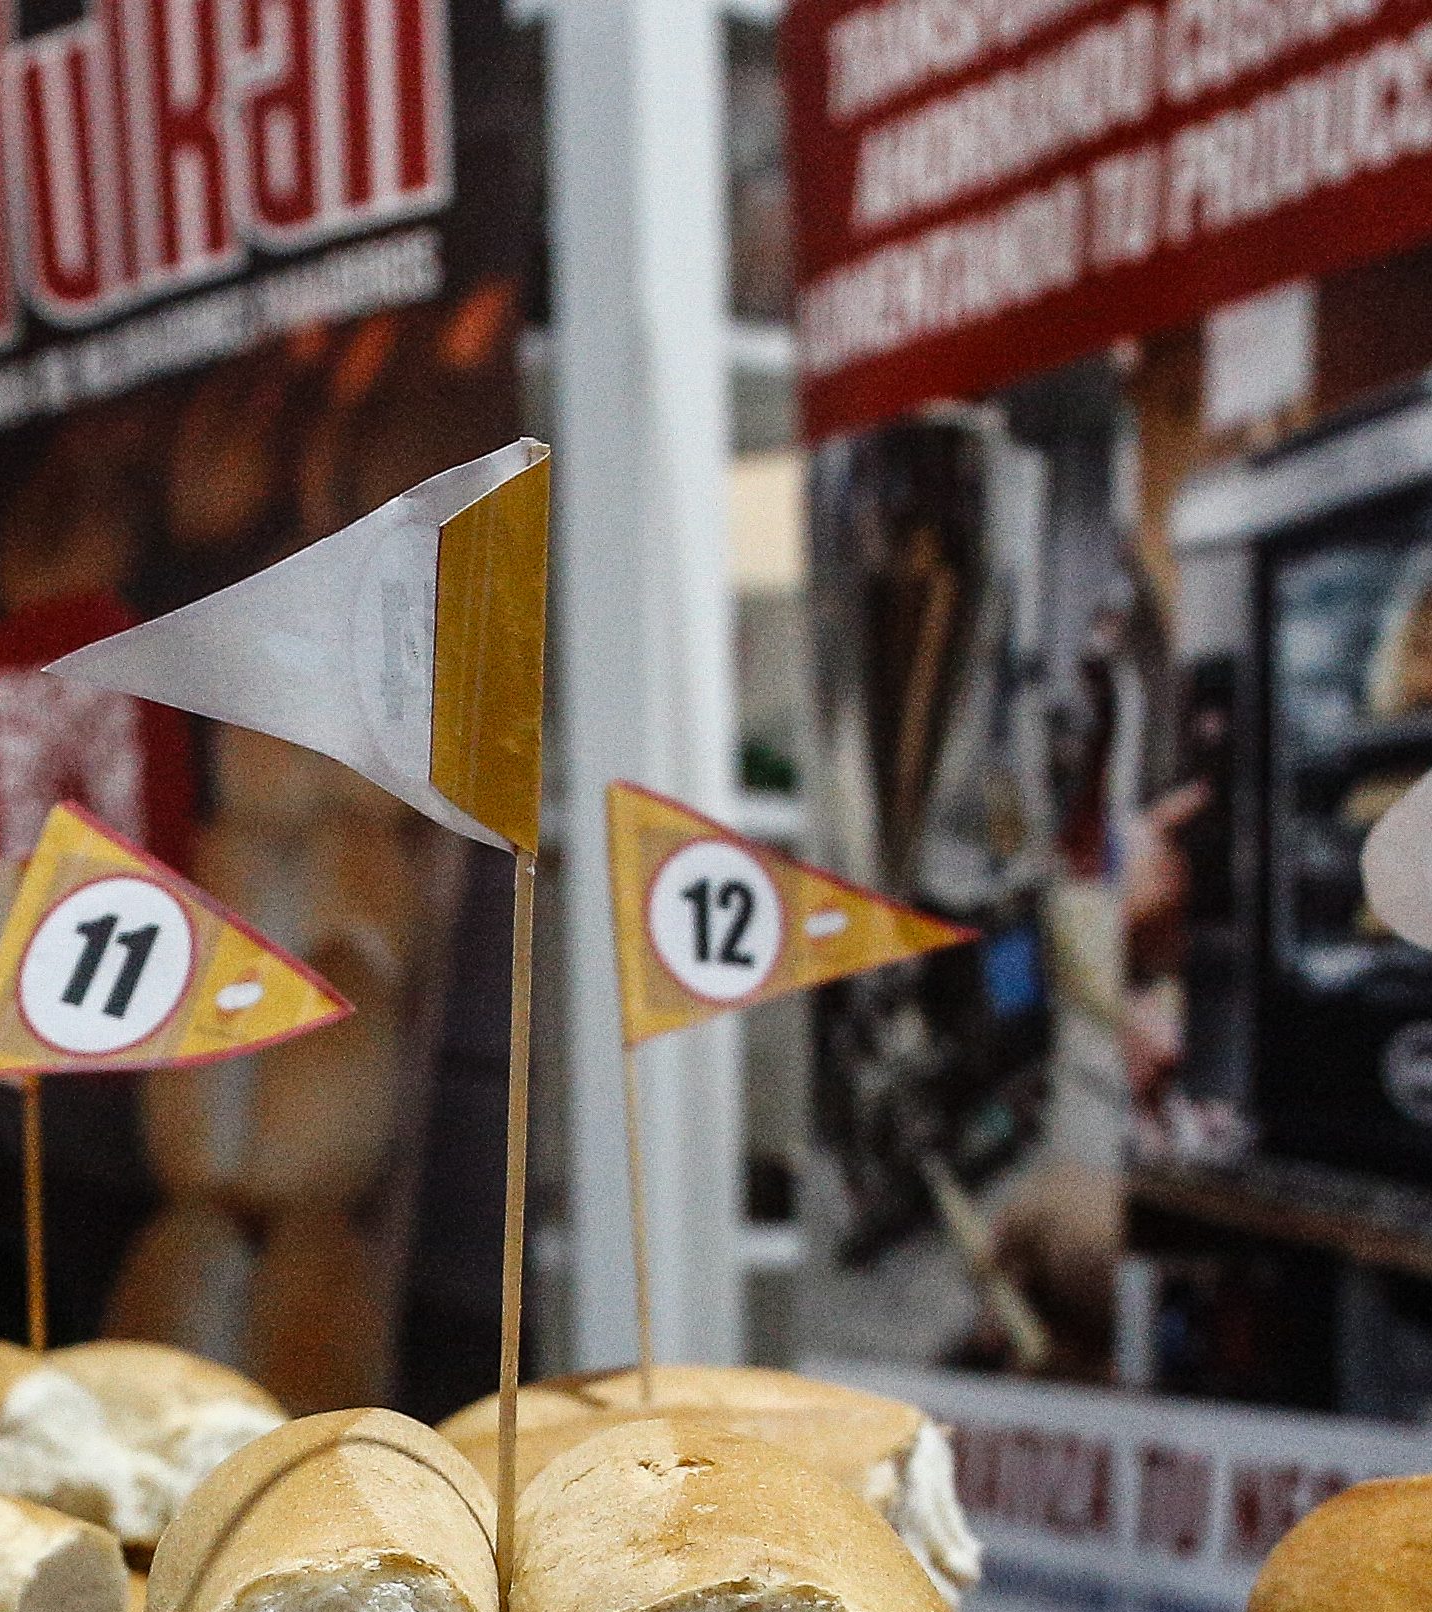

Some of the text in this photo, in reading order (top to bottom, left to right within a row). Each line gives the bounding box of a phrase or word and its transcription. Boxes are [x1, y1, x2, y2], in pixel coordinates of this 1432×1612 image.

[1090, 142, 1158, 268] TU
[60, 911, 163, 1021] 11
[679, 874, 757, 970] 12
[1138, 1438, 1224, 1560] TU
